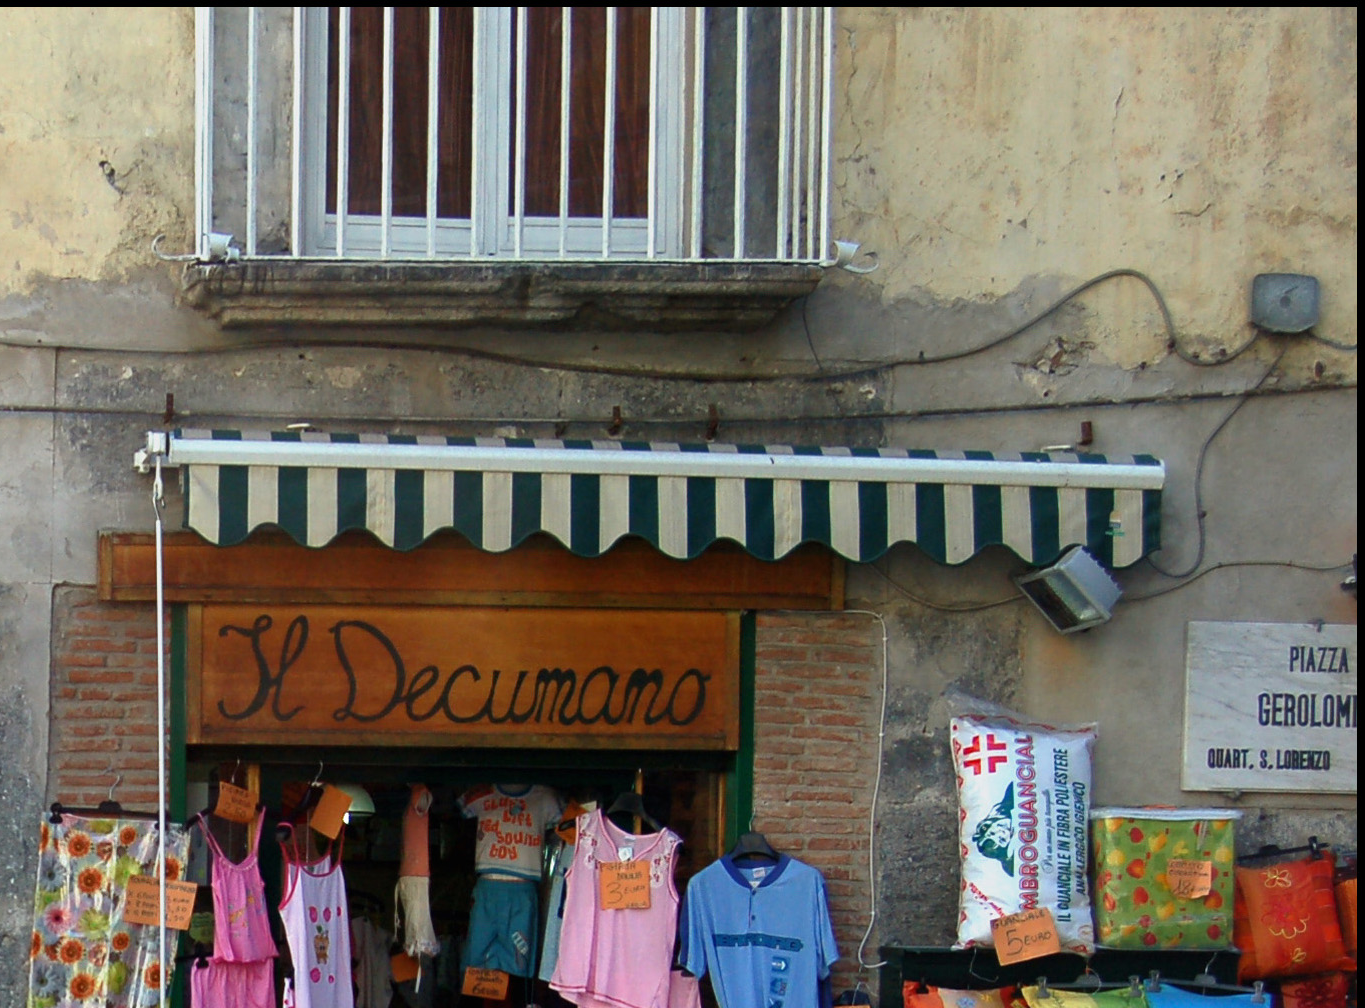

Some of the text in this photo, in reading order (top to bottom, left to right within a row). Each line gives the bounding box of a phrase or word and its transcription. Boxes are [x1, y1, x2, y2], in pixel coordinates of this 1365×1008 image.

[218, 614, 712, 727] Il Decumano
[1289, 645, 1350, 673] PIAZZA
[1207, 747, 1254, 770] QUART.
[1276, 749, 1331, 771] LORENZO
[1014, 734, 1039, 911] MBROGUANCIAL
[1053, 747, 1071, 922] IL GUANCIALE IN FIBRA POLIESTERE
[606, 881, 624, 905] 3
[1005, 929, 1052, 957] 5 EURO
